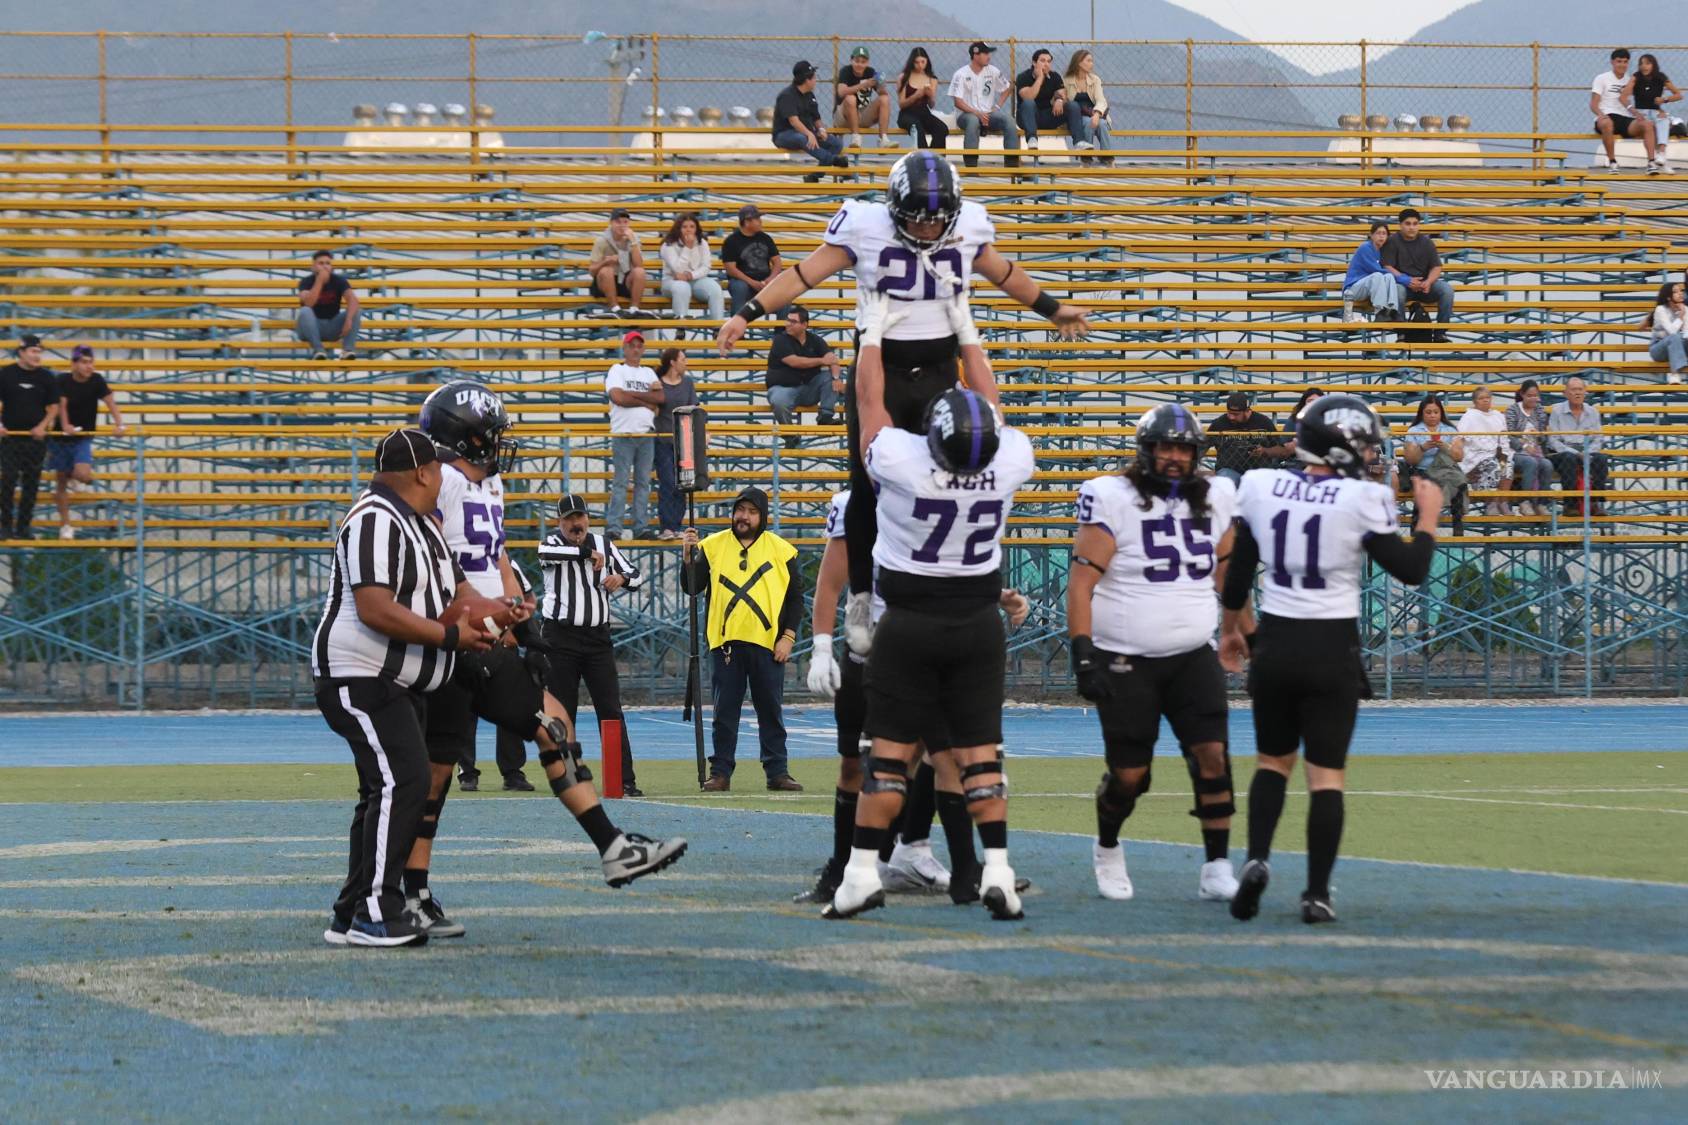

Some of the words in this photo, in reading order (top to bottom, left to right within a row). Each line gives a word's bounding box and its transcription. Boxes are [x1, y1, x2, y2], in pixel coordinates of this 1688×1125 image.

[1272, 477, 1341, 504] UACH
[911, 497, 1004, 566] 72
[1141, 517, 1214, 582] 55
[1271, 509, 1326, 589] 11
